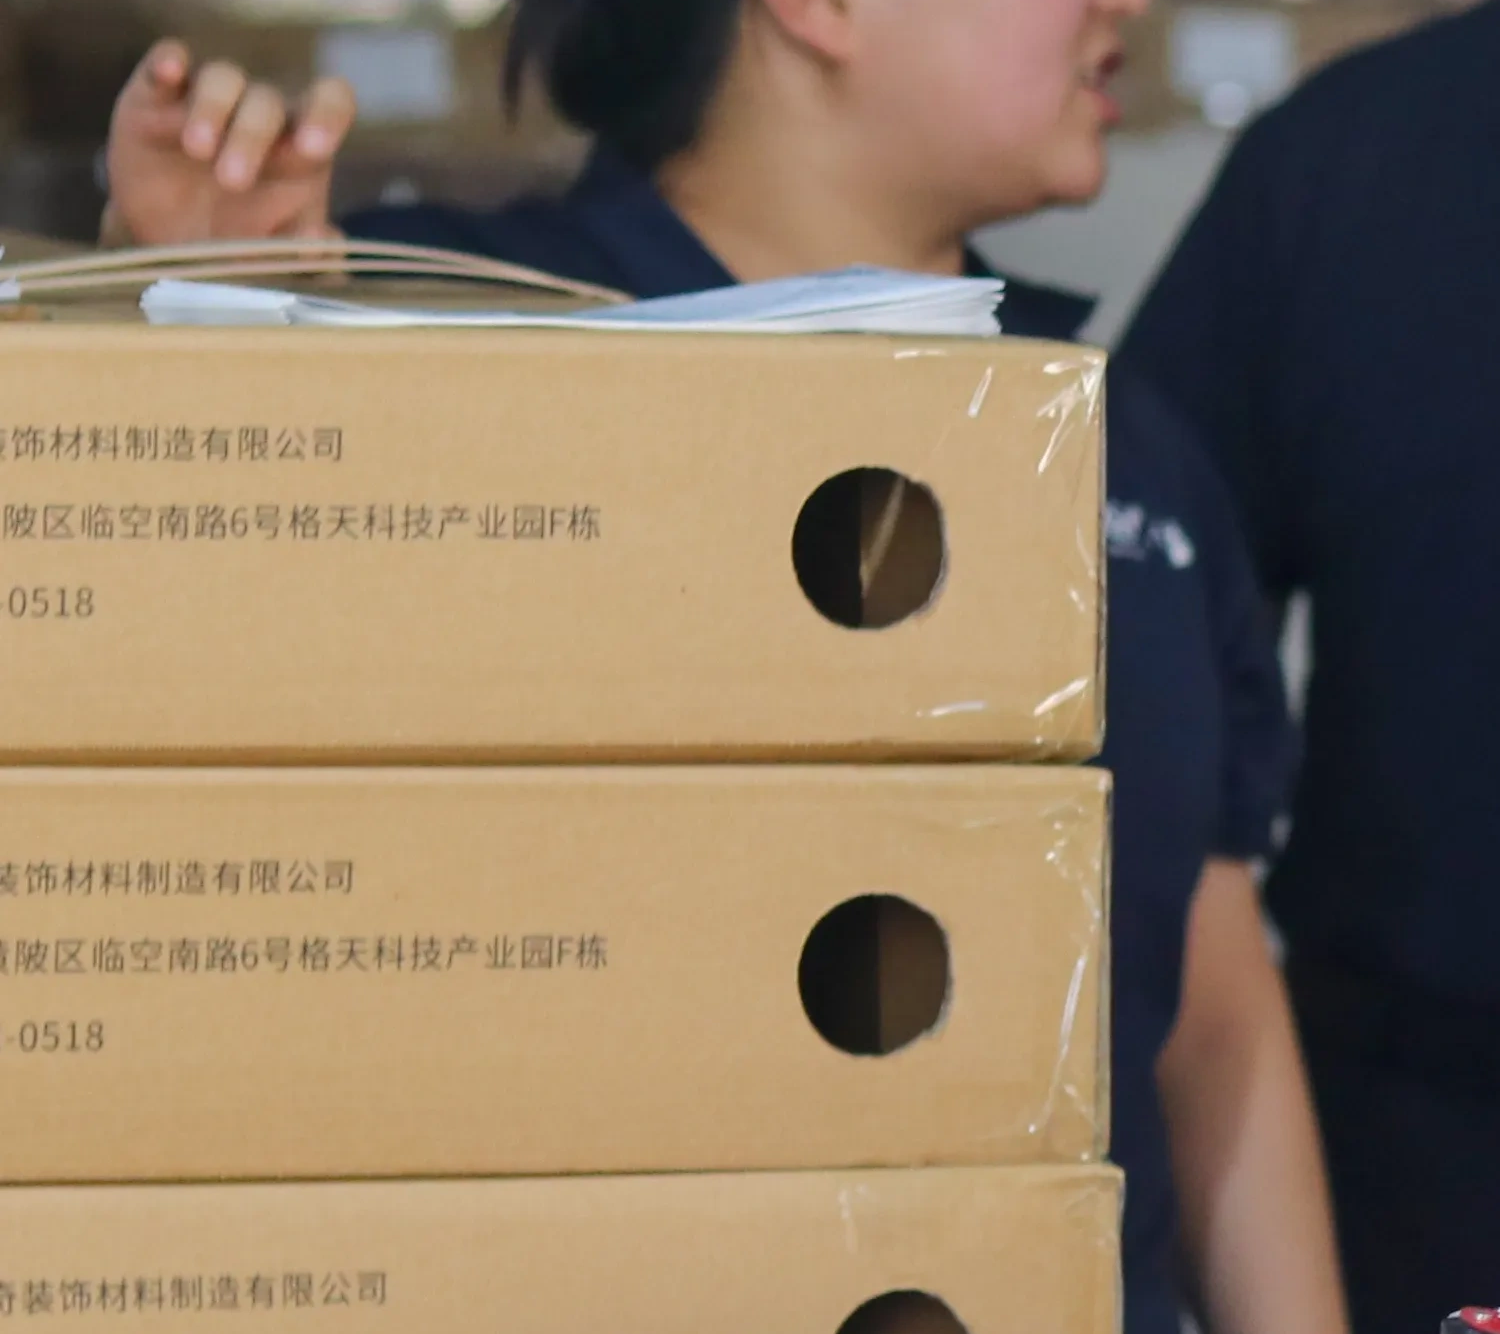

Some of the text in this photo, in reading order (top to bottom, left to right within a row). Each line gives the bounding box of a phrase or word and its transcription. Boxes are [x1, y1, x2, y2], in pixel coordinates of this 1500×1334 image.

[0, 425, 344, 461] 饰材料制造有限公司
[0, 932, 608, 974] 陂区临空南路6号格天科技产业园F栋
